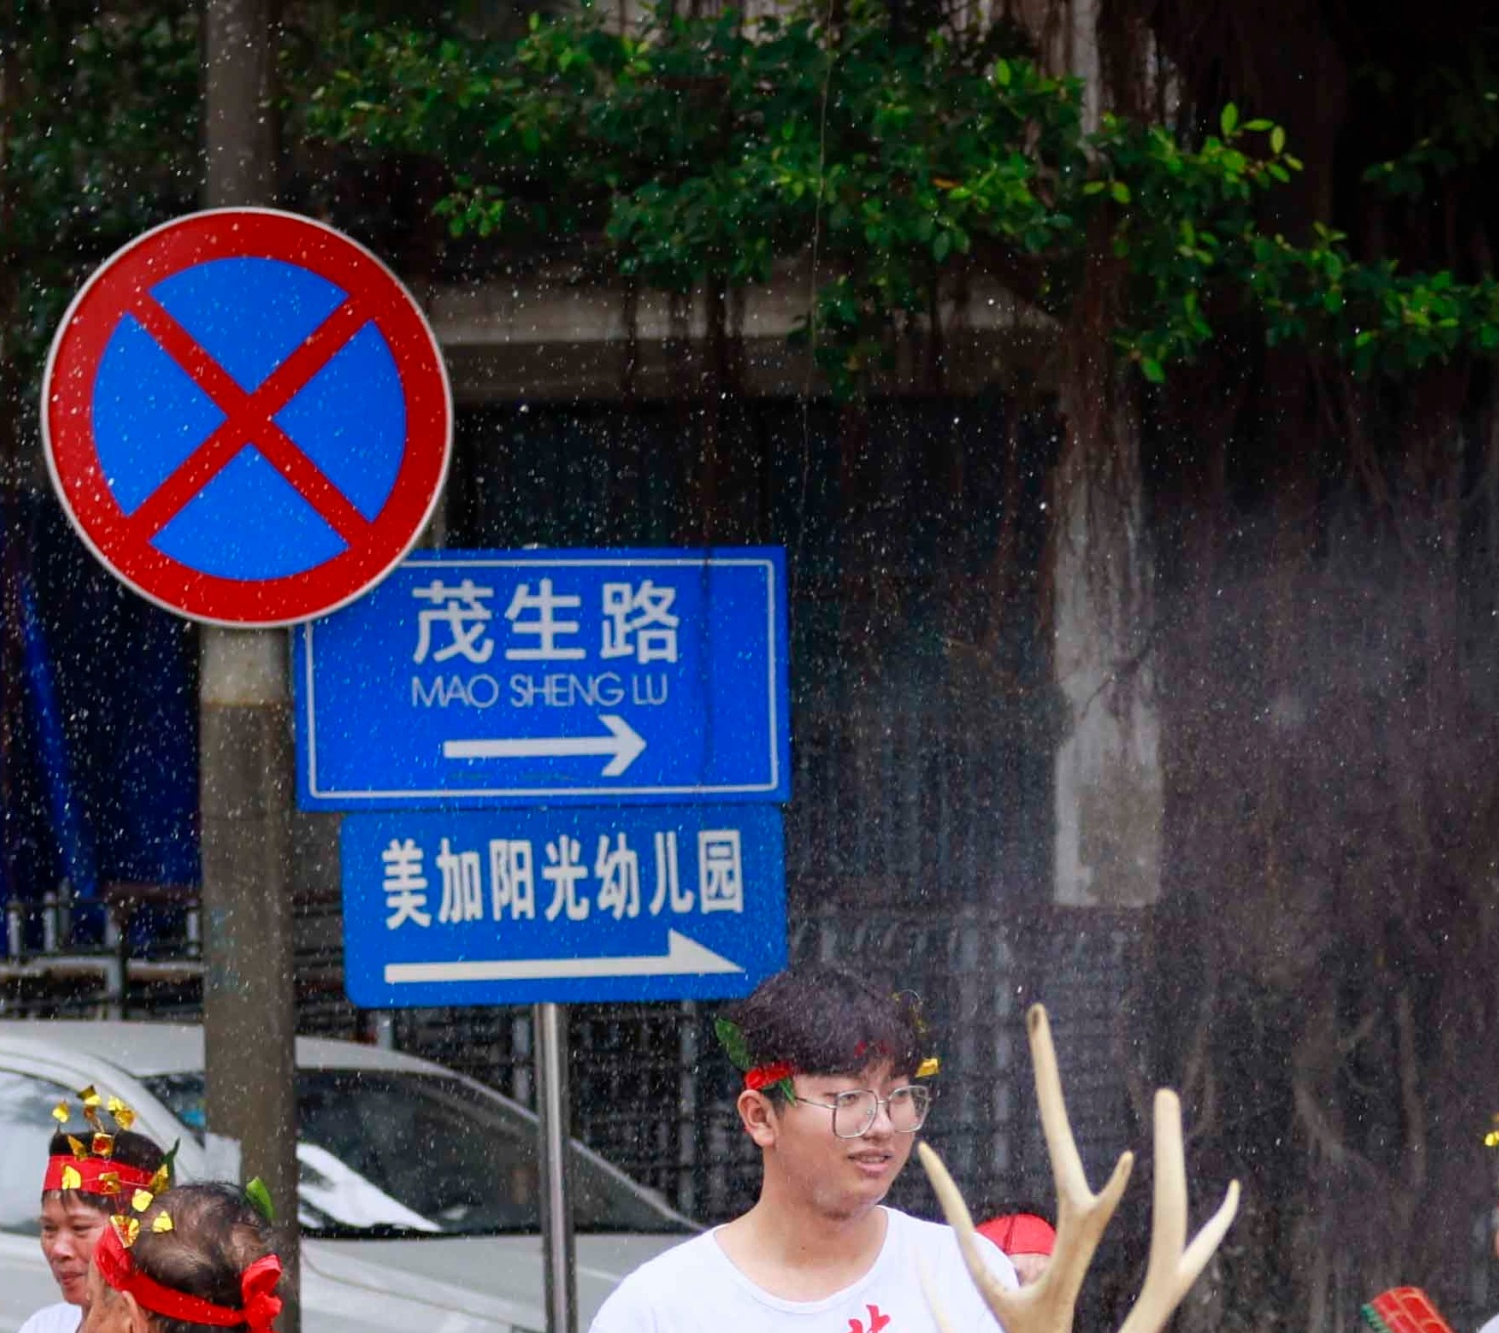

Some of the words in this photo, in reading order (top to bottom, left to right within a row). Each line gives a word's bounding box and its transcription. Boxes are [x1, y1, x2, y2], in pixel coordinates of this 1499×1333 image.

[412, 578, 679, 664] 茂生路
[411, 674, 499, 708] MAO
[509, 673, 625, 707] SHENG
[632, 673, 668, 705] LU
[381, 829, 744, 930] 美加阳光幼儿园
